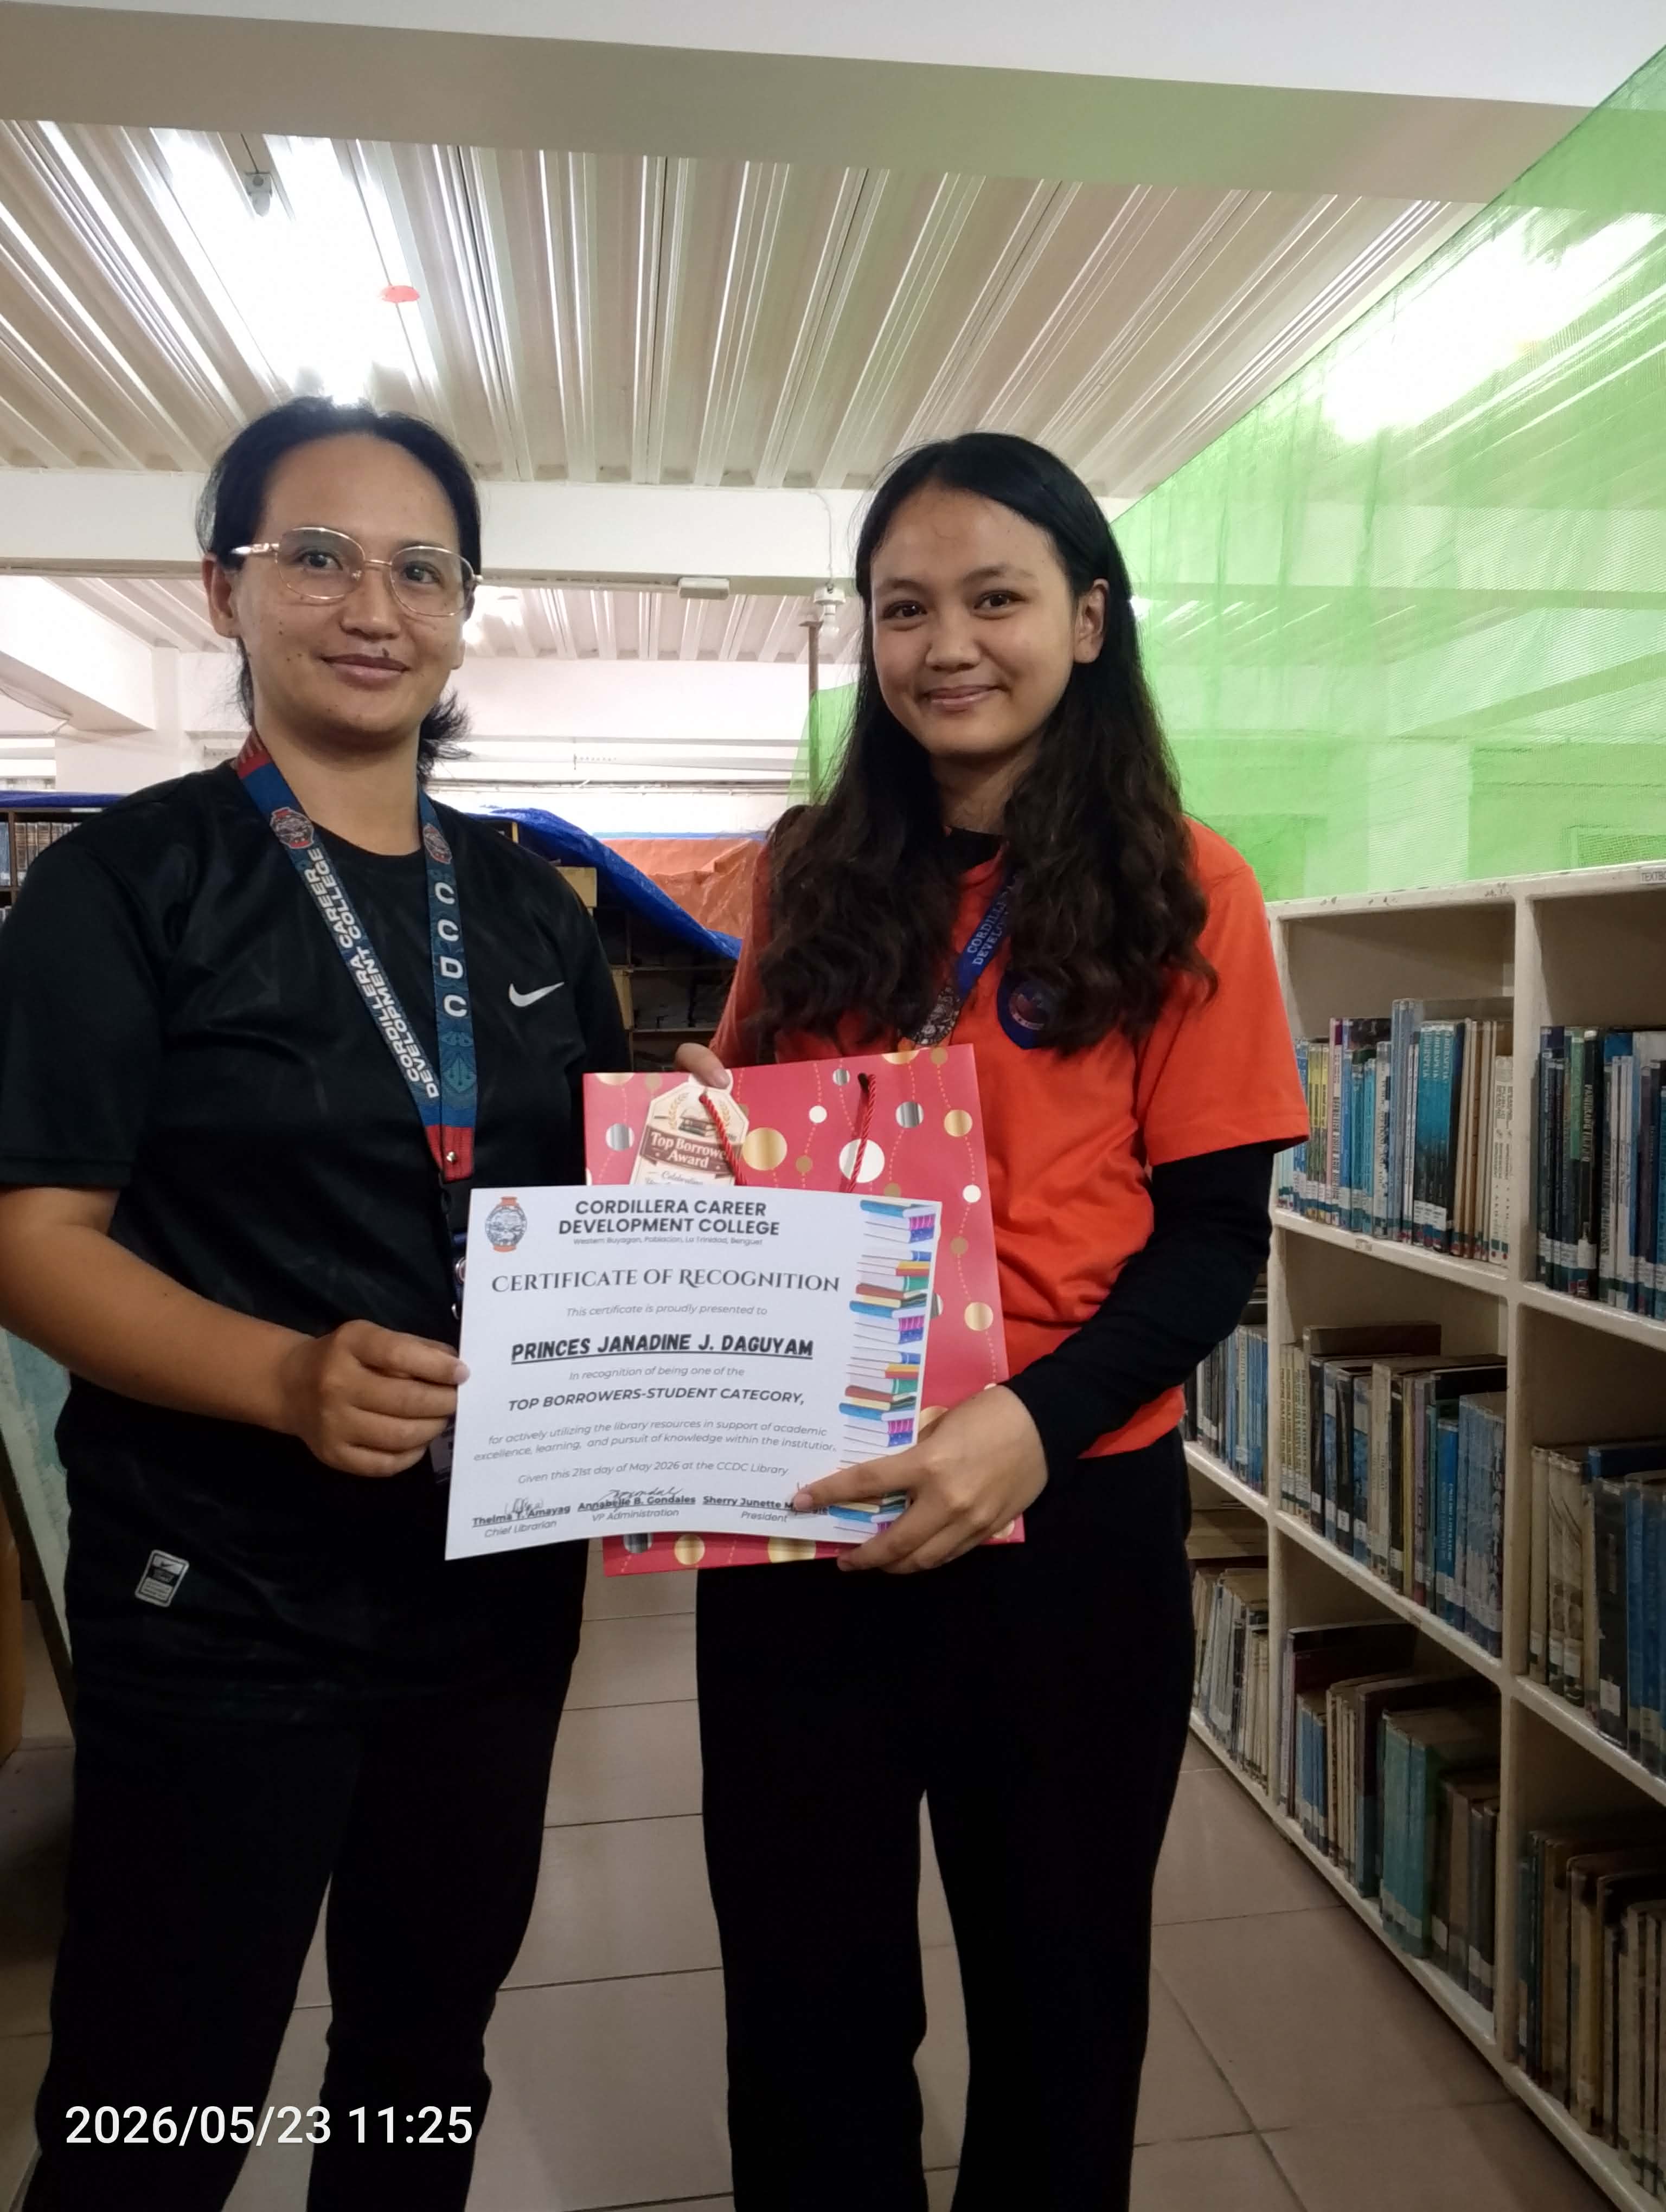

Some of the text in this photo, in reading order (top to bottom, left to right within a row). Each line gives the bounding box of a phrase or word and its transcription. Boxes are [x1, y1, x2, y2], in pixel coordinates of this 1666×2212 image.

[304, 867, 420, 1083] CORDILLERA CAREER
[308, 848, 440, 1099] DEVELOPMENT COLLEGE
[651, 1132, 727, 1159] Top Borrowe
[667, 1149, 710, 1168] Award
[575, 1200, 766, 1216] CORDILLERA CAREER
[559, 1218, 780, 1235] DEVELOPMENT COLLEGE
[491, 1269, 840, 1293] CERTIFICATE OF RECOGNITION
[567, 1304, 768, 1317] This certificate is proudly presented to
[511, 1334, 813, 1362] PRINCES JANADINE J. DAGUYAM
[569, 1366, 745, 1382] In recognition of being one of the
[508, 1388, 805, 1411] TOP BORROWERS-STUDENT CATEGORY,
[489, 1419, 828, 1445] for actively utilizing the library resources in support of academic
[473, 1446, 534, 1462] excellence,
[535, 1439, 582, 1455] learning,
[587, 1436, 608, 1448] and
[611, 1435, 649, 1447] pursuit
[651, 1433, 663, 1443] of
[664, 1432, 723, 1444] knowledge
[726, 1433, 759, 1445] within
[761, 1436, 780, 1447] the
[518, 1461, 789, 1484] Given this 21st day of May 2026 at the CCDC Library
[703, 1495, 736, 1507] Sherry
[740, 1498, 781, 1509] Junette
[472, 1513, 512, 1527] Thelma
[528, 1505, 571, 1518] Amayag
[592, 1508, 680, 1522] VP Administration
[741, 1510, 787, 1523] President
[484, 1520, 558, 1538] Chief Librarian
